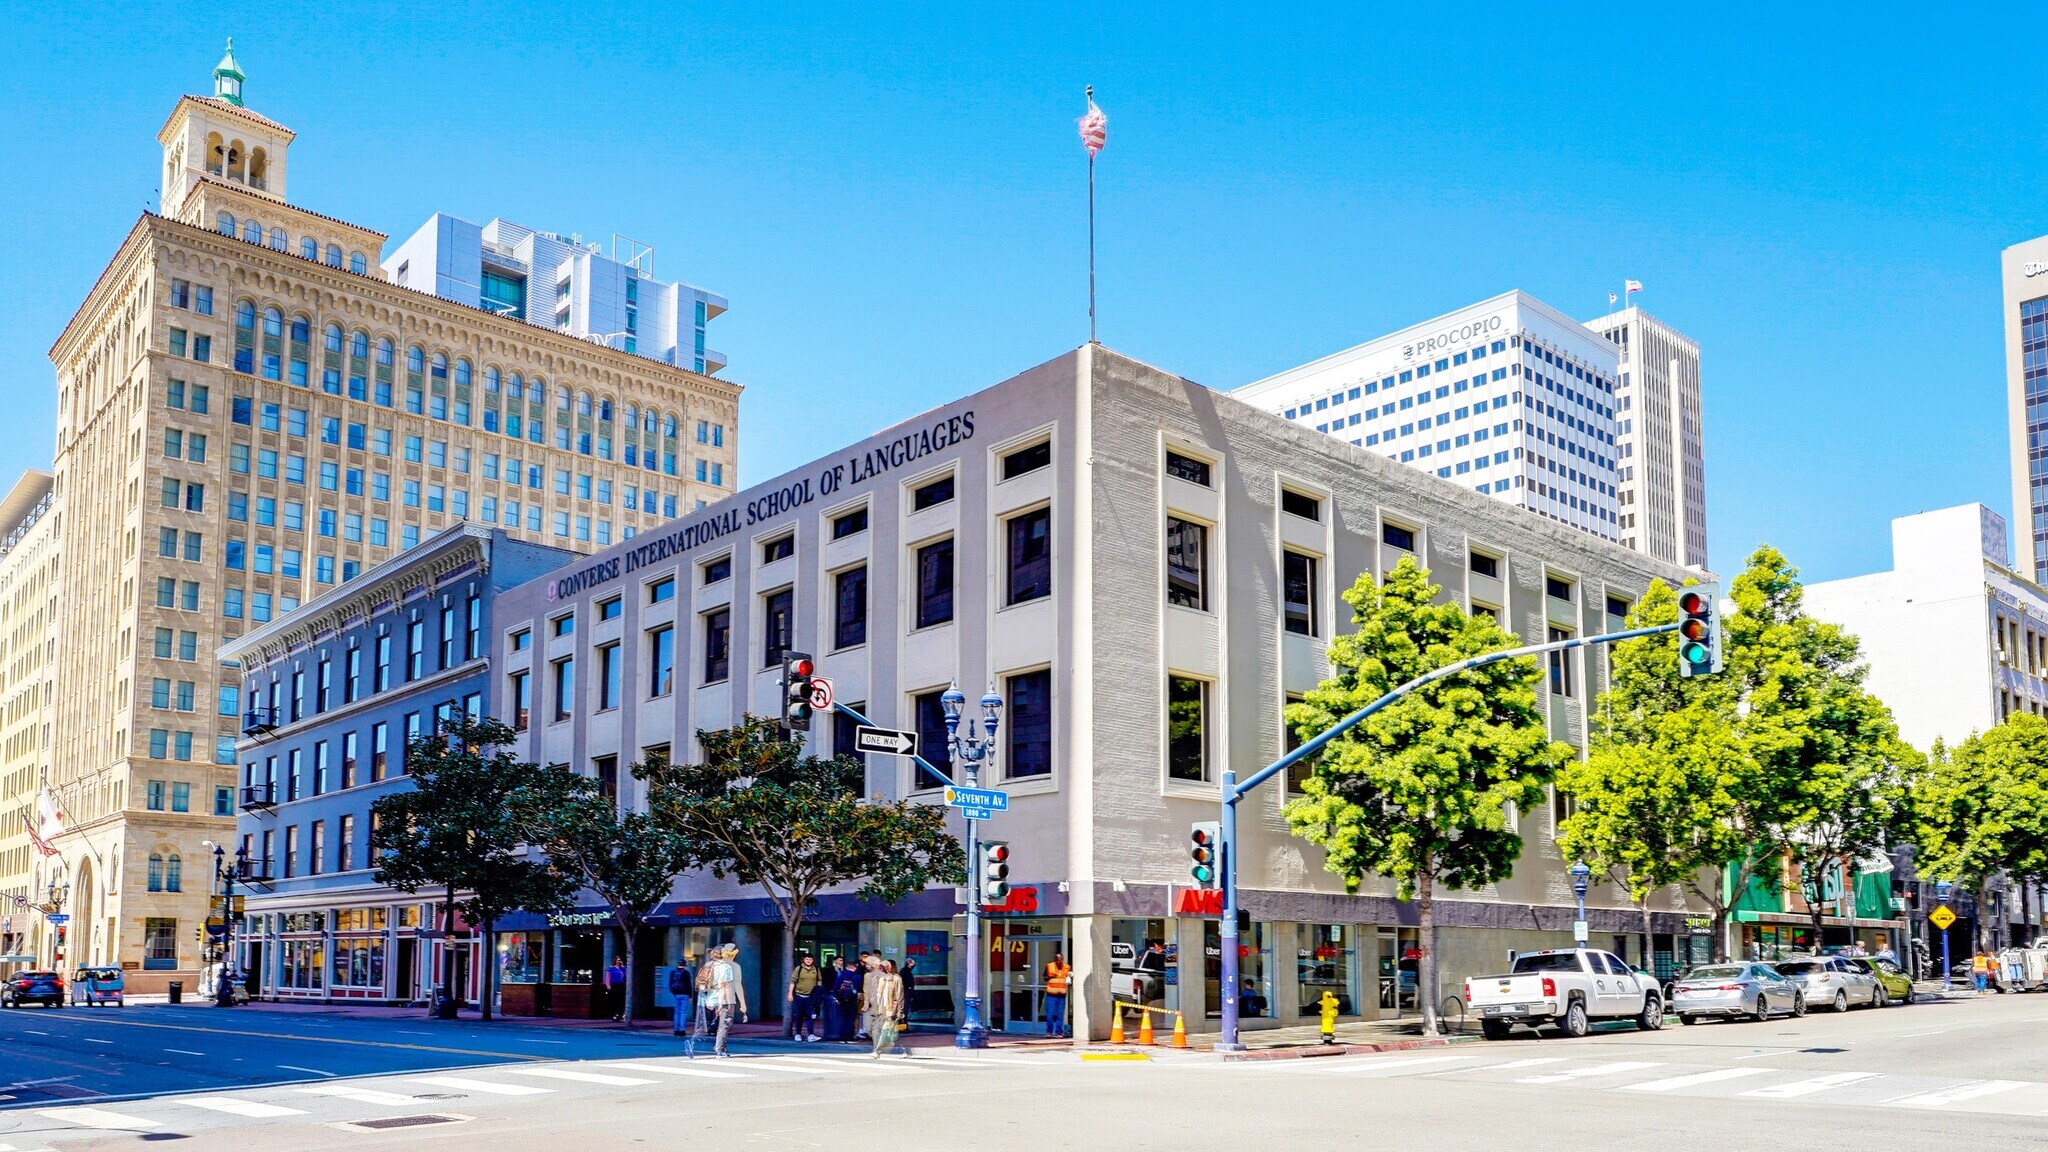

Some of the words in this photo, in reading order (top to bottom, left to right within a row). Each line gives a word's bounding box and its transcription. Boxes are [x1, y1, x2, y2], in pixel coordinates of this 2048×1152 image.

[2024, 259, 2048, 278] Th
[1416, 316, 1502, 356] PROCOPIO
[557, 556, 620, 600] CONVERSE
[625, 509, 742, 575] INTERNATIONAL
[747, 478, 814, 524] SCHOOL
[820, 466, 845, 496] OF
[850, 411, 975, 485] LANGUAGES
[866, 735, 881, 745] ONE
[883, 737, 898, 747] WAY
[956, 790, 989, 805] SEVENTH
[991, 935, 1026, 953] AIS
[1113, 945, 1130, 955] Uber
[1205, 946, 1221, 955] Uber
